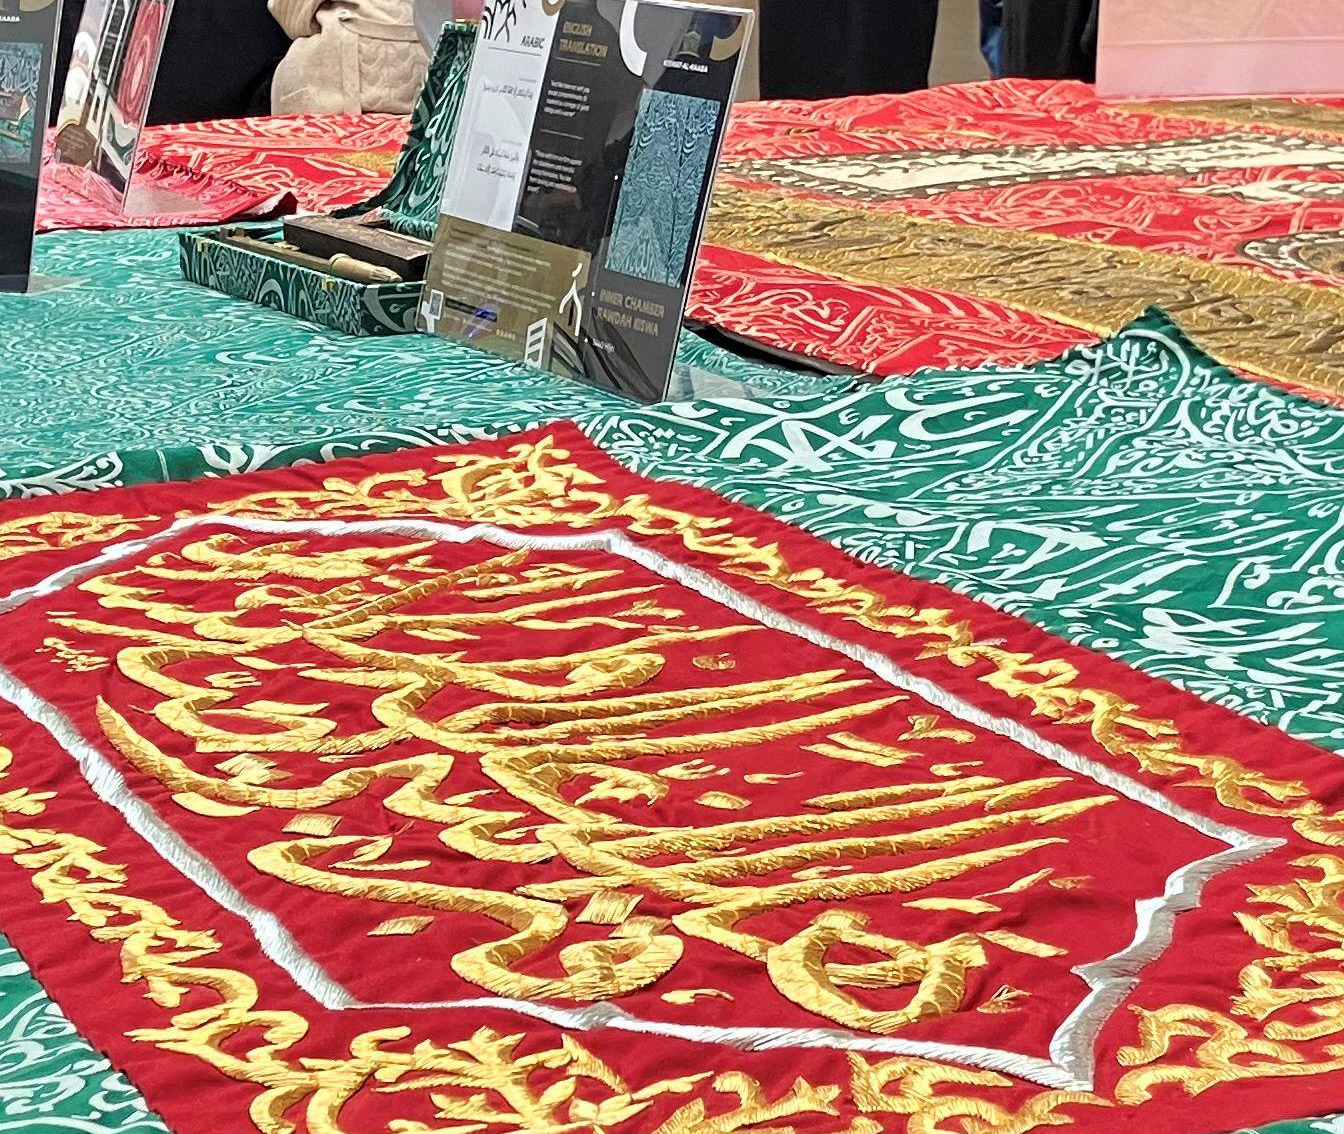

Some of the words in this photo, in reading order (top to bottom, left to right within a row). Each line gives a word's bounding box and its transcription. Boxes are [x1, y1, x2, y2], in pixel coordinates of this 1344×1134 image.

[563, 21, 593, 37] ENGLISH
[520, 35, 545, 49] ARABIC
[559, 38, 609, 58] TRANSLATION
[599, 288, 624, 306] INNER
[624, 294, 665, 318] CHAMBER
